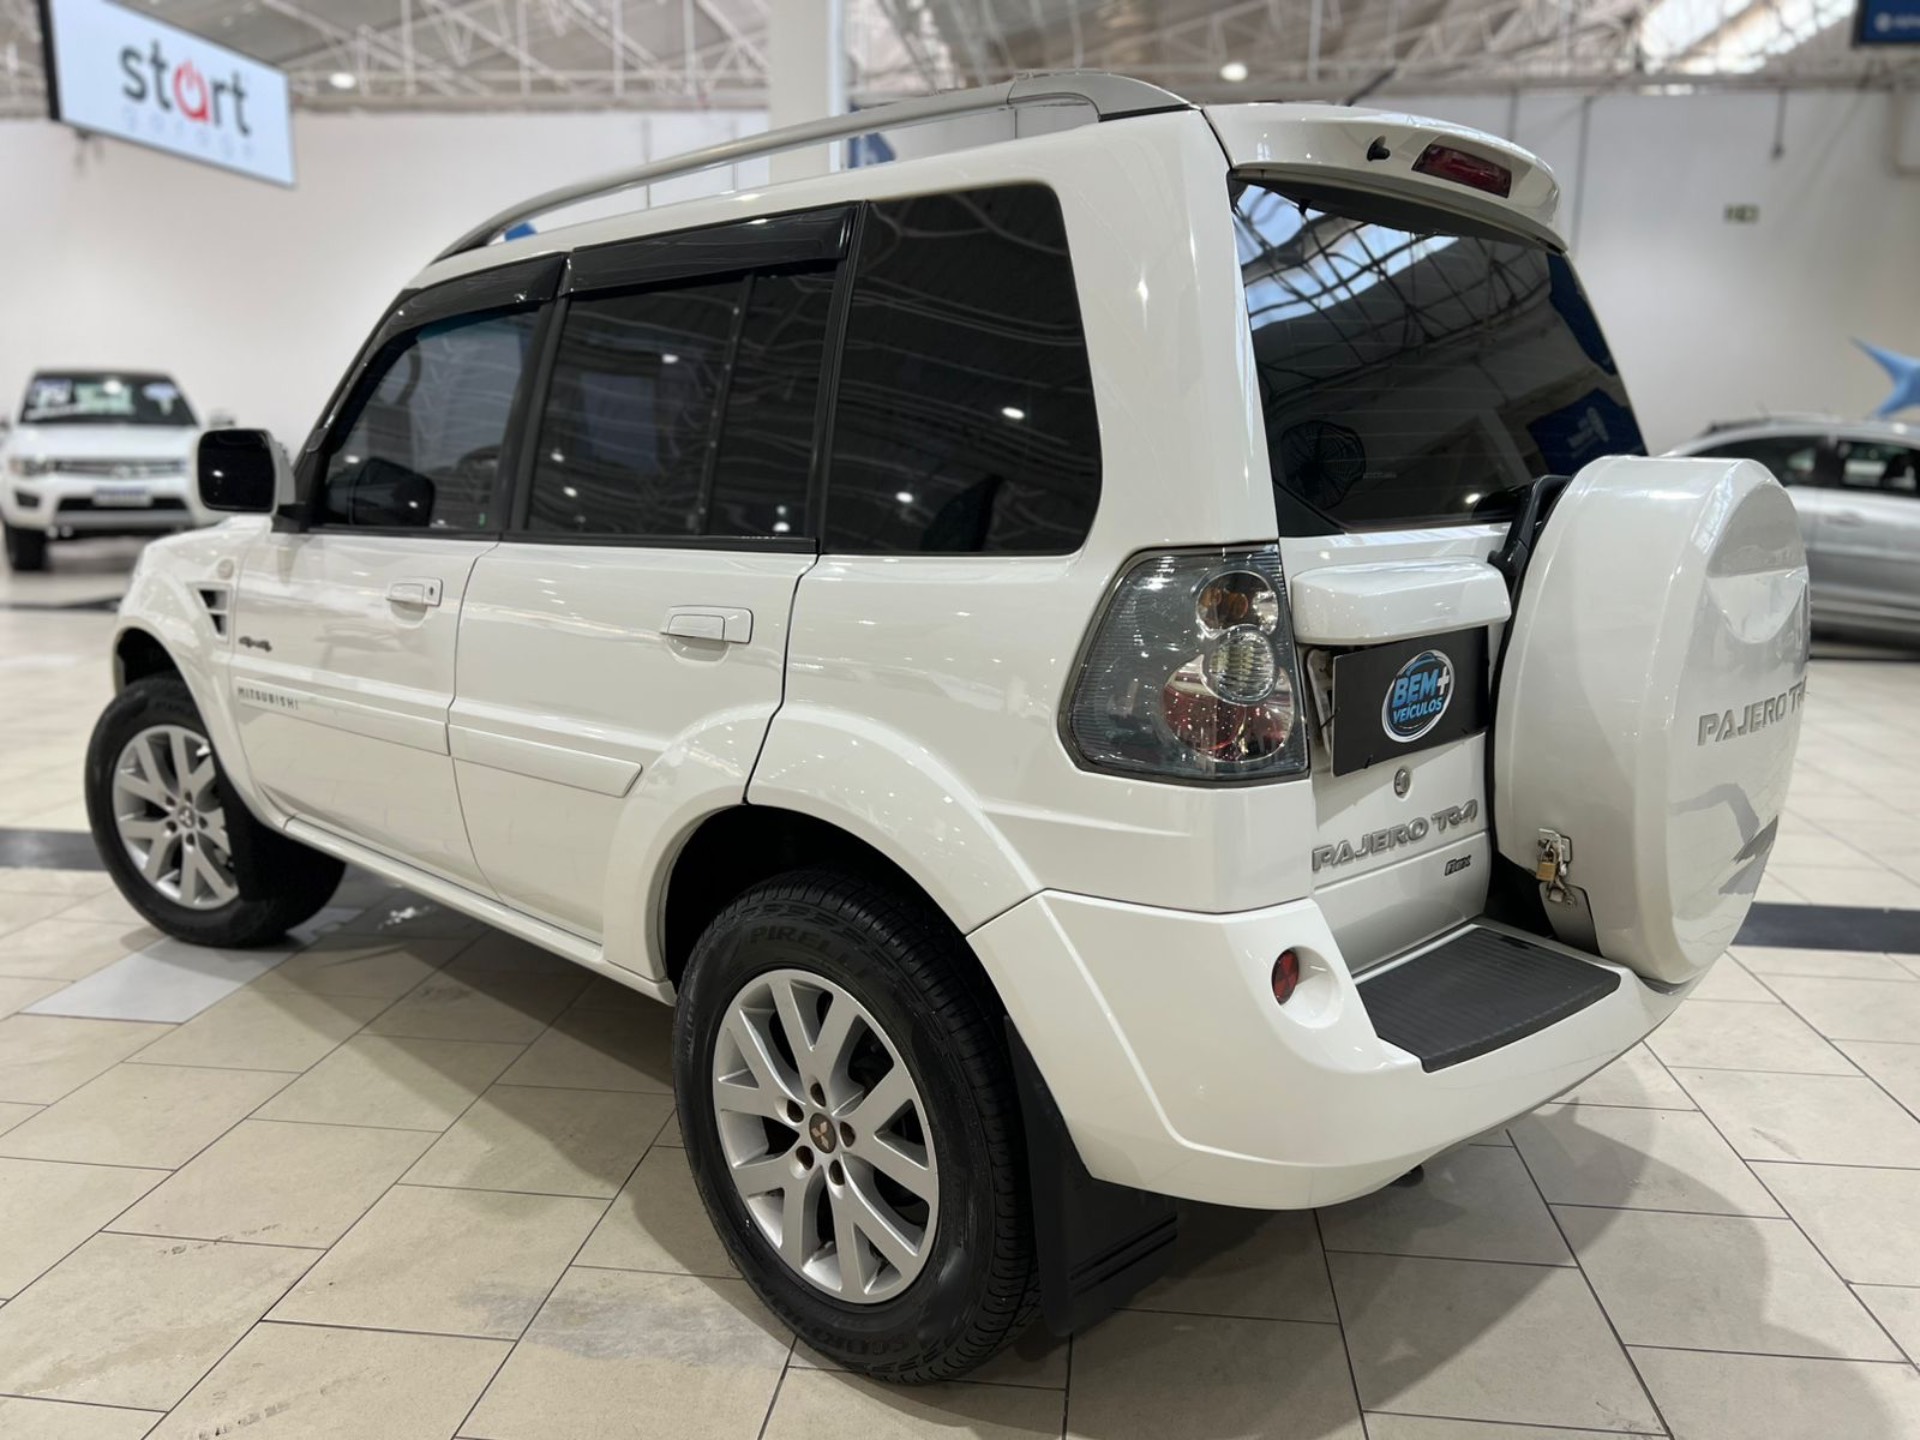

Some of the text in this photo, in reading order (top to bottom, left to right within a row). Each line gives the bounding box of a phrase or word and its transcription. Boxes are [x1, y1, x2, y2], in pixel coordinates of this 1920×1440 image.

[119, 39, 252, 137] start
[238, 687, 299, 710] MITSUBISHI
[1698, 692, 1787, 746] PAJERO
[1312, 798, 1479, 872] PAJERO TR4
